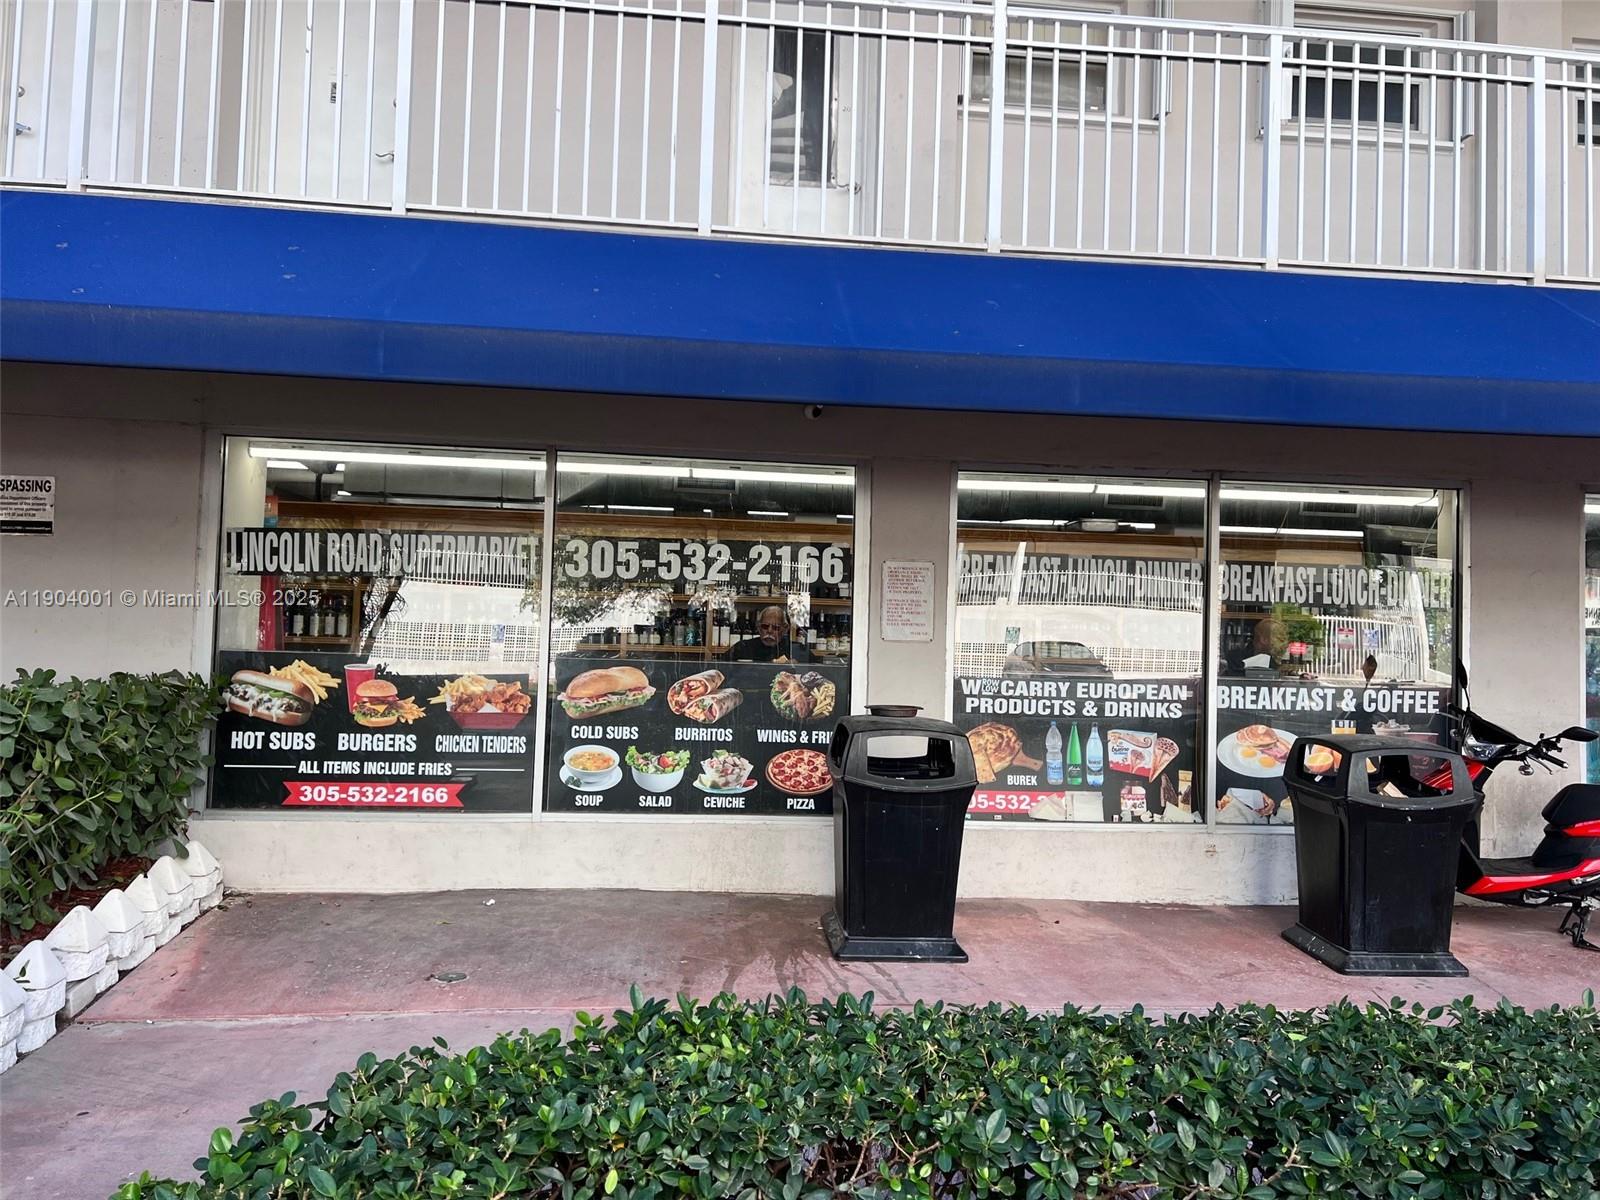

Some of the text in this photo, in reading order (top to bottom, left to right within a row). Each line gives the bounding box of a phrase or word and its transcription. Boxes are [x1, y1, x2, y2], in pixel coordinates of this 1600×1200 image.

[0, 479, 52, 492] SPASSING
[230, 531, 539, 576] LINCOLN ROAD SUPERMARKET
[564, 539, 844, 584] 305-532-2166
[1000, 680, 1071, 698] CARRY
[1077, 683, 1187, 700] EUROPEAN
[1217, 686, 1440, 713] BREAKFAST & COFFEE
[965, 698, 1183, 718] PRODUCTS & DRINKS
[571, 726, 639, 740] COLD SUBS
[674, 728, 733, 742] BURRITOS
[756, 729, 833, 744] WINGS & FRI
[230, 731, 316, 751] HOT SUBS
[337, 733, 417, 752] BURGERS
[435, 734, 526, 754] CHICKEN TENDERS
[297, 761, 452, 776] ALL ITEMS INCLUDE FRIES
[1007, 775, 1038, 786] BUREK
[299, 785, 449, 804] 305-532-2166
[575, 795, 603, 807] SOUP
[638, 796, 672, 808] SALAD
[703, 796, 746, 809] CEVICHE
[786, 798, 815, 810] PIZZA
